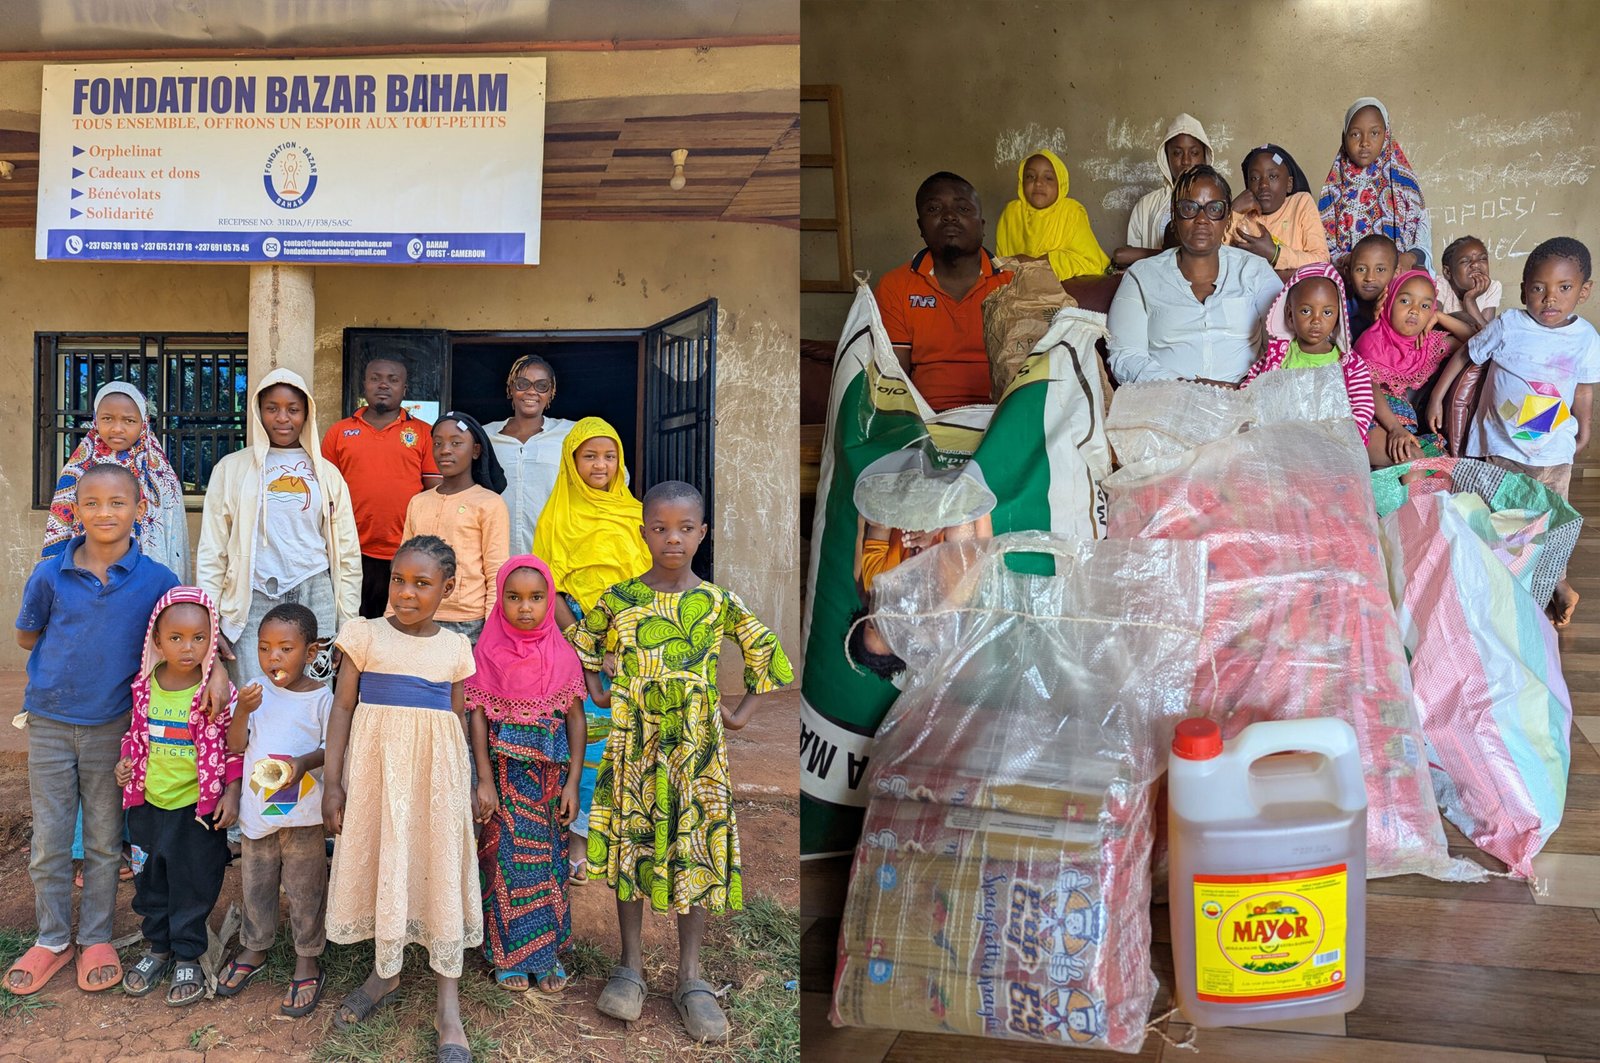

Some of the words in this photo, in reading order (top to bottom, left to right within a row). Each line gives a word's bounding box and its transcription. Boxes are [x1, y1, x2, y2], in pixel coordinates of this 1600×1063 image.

[73, 76, 256, 115] FONDATION
[265, 75, 376, 113] BAZAR
[386, 73, 508, 113] BAHAM
[72, 118, 112, 130] TOUS
[117, 118, 200, 130] ENSEMBLE,
[204, 117, 275, 129] OFFRONS
[279, 117, 301, 129] UN
[306, 117, 361, 129] ESPOIR
[366, 117, 398, 129] AUX
[403, 116, 507, 129] TOUT-PETITS
[88, 145, 163, 161] Orphelinat
[264, 141, 297, 174] FONDATION
[302, 147, 317, 173] BAZAR
[88, 166, 146, 179] Cadeaux
[150, 168, 164, 179] et
[168, 166, 200, 179] dons
[87, 187, 161, 200] Bénévolats
[276, 197, 304, 208] BAHAM
[86, 207, 154, 220] Solidarité
[218, 218, 258, 226] RECEPISSE
[85, 242, 100, 250] +237
[101, 242, 112, 250] 657
[113, 242, 121, 250] 39
[123, 242, 130, 250] 10
[131, 242, 138, 250] 13
[141, 242, 155, 251] +237
[156, 242, 167, 251] 675
[168, 243, 175, 251] 21
[177, 243, 184, 251] 37
[195, 243, 210, 252] +237
[232, 243, 240, 252] 75
[241, 243, 250, 252] 45
[283, 240, 392, 248] contact@fondationbazarbaham.com
[426, 241, 449, 249] BAHAM
[283, 248, 387, 256] fondationbazarbaham@gmail.com
[426, 249, 446, 258] OUEST
[451, 249, 486, 258] CAMEROUN
[909, 295, 937, 308] TVR
[152, 706, 187, 718] OMM
[150, 746, 195, 757] LFIGER
[1232, 916, 1309, 944] MAYOR
